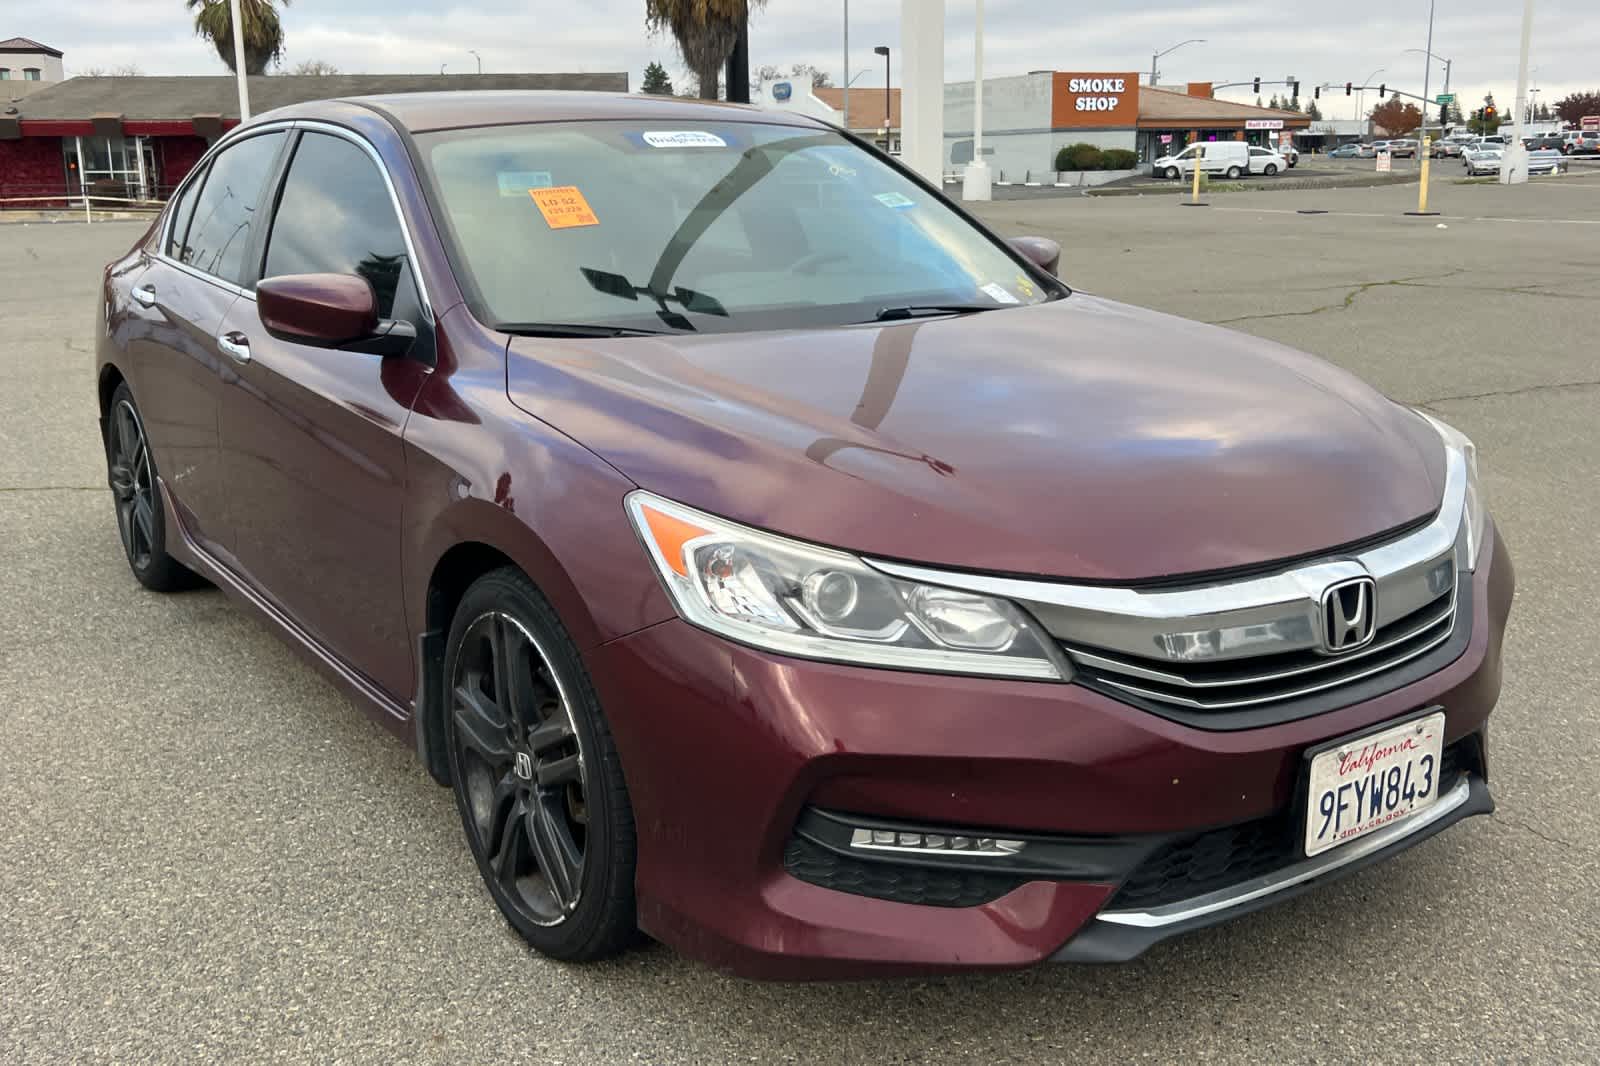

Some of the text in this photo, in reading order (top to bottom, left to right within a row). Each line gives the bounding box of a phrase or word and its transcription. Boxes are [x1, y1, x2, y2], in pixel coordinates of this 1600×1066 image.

[1069, 79, 1125, 93] SMOKE
[1075, 97, 1119, 111] SHOP
[1340, 739, 1419, 776] California
[1318, 754, 1434, 840] 9FYW843
